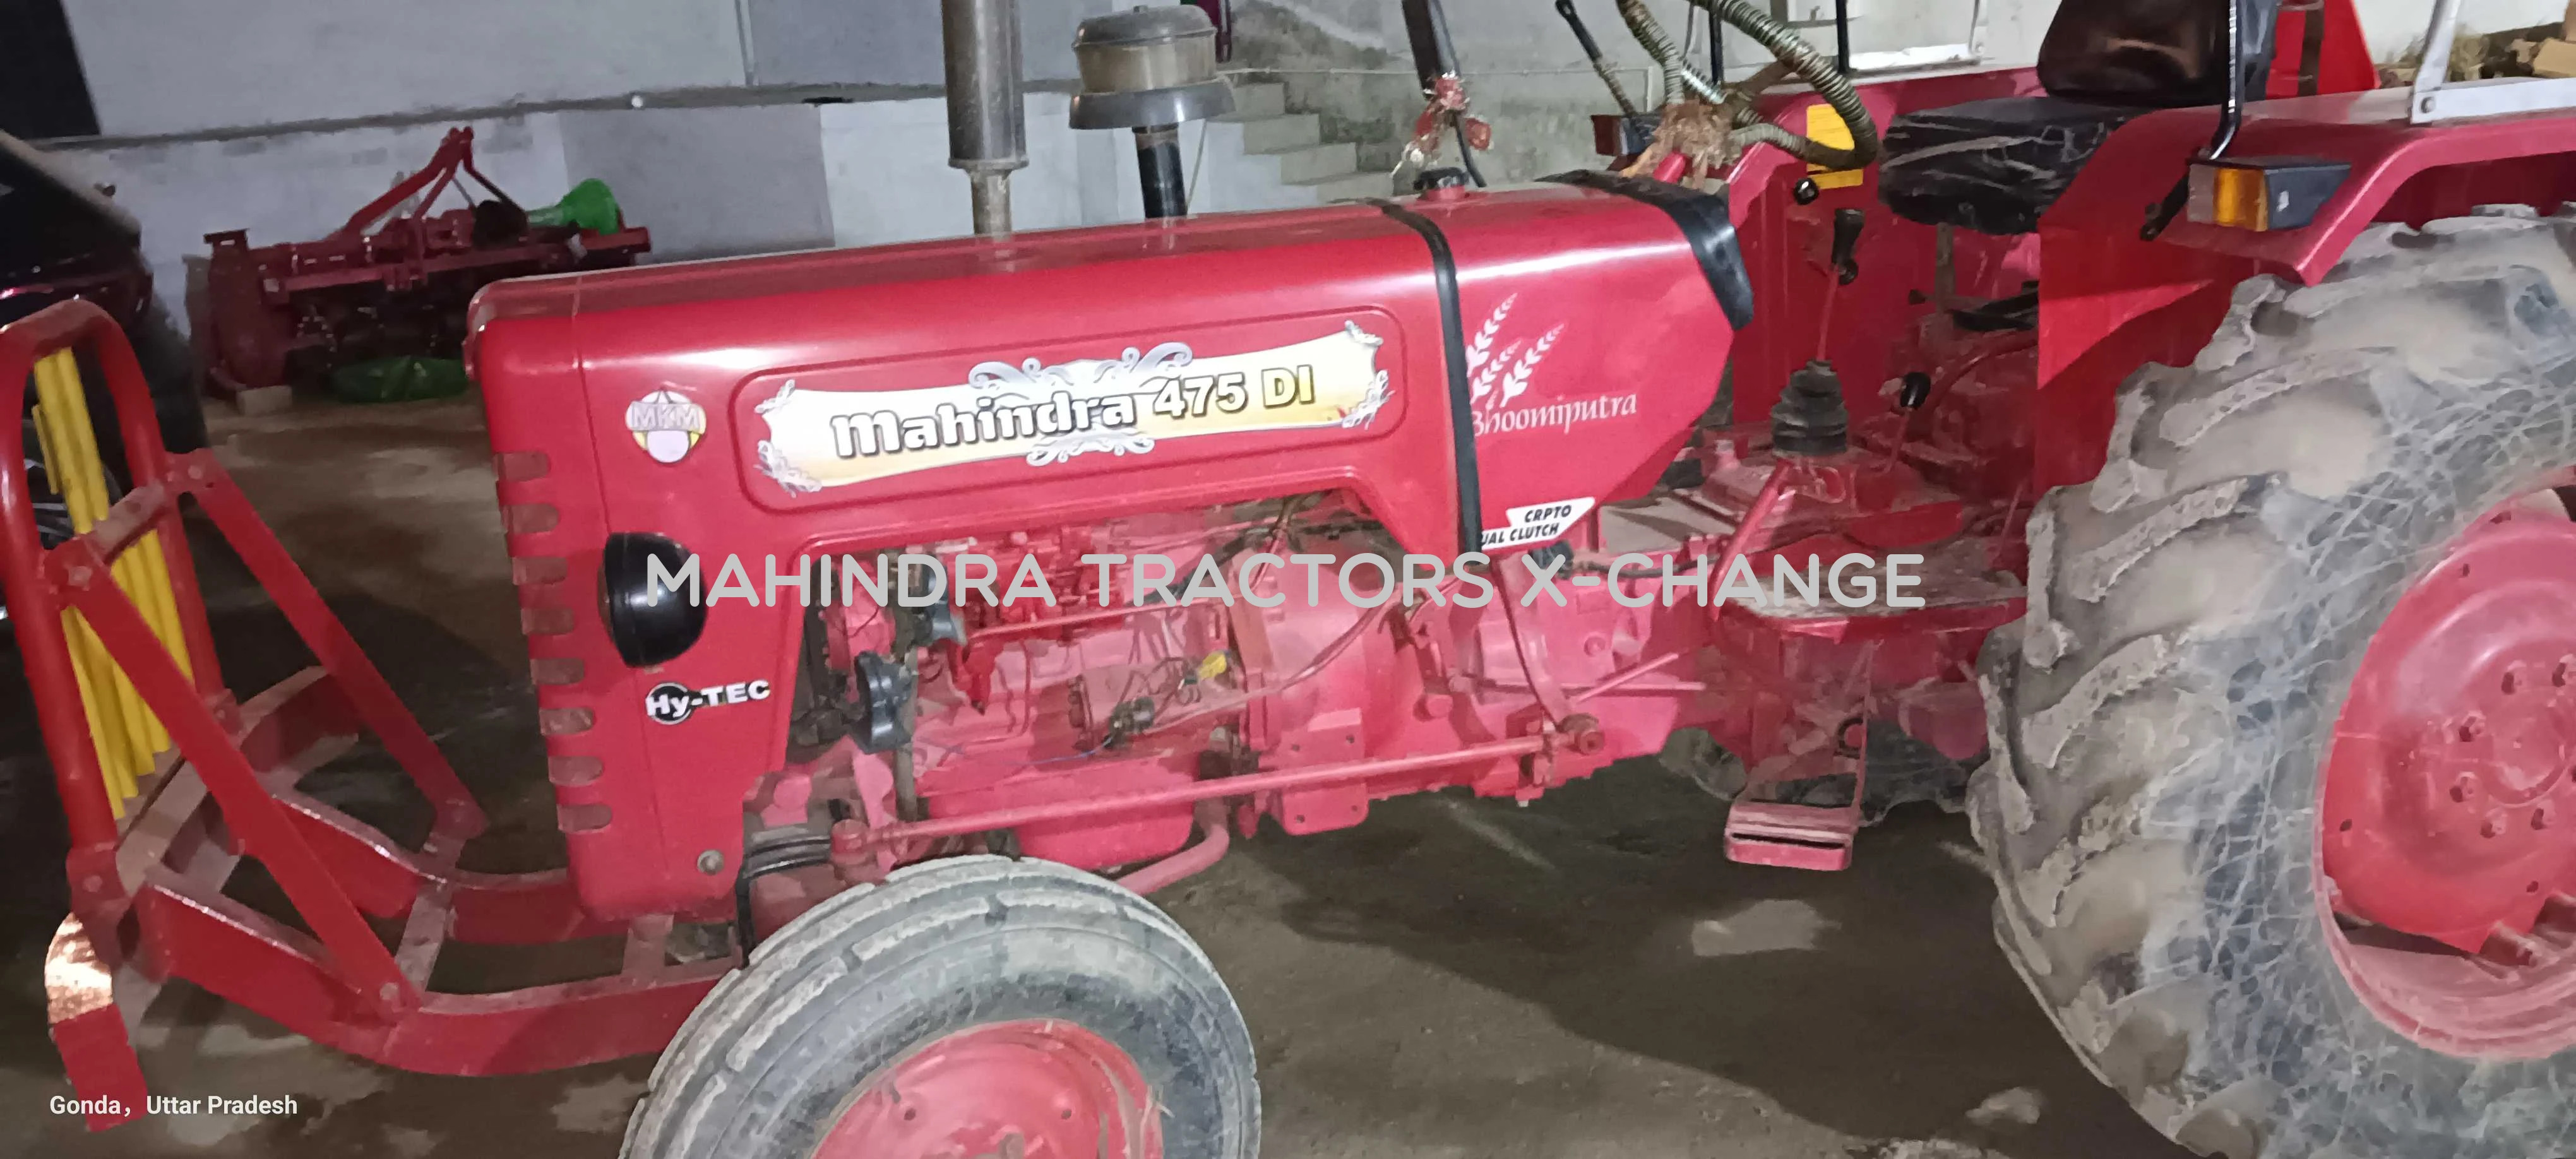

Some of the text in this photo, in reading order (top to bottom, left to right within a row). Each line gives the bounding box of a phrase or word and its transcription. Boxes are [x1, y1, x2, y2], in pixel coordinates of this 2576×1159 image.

[830, 365, 1316, 458] Mahindra 475 DI
[1525, 505, 1571, 523] CRPTO
[1481, 523, 1559, 545] UAL CLUTCH
[646, 679, 771, 718] Hy-TEC
